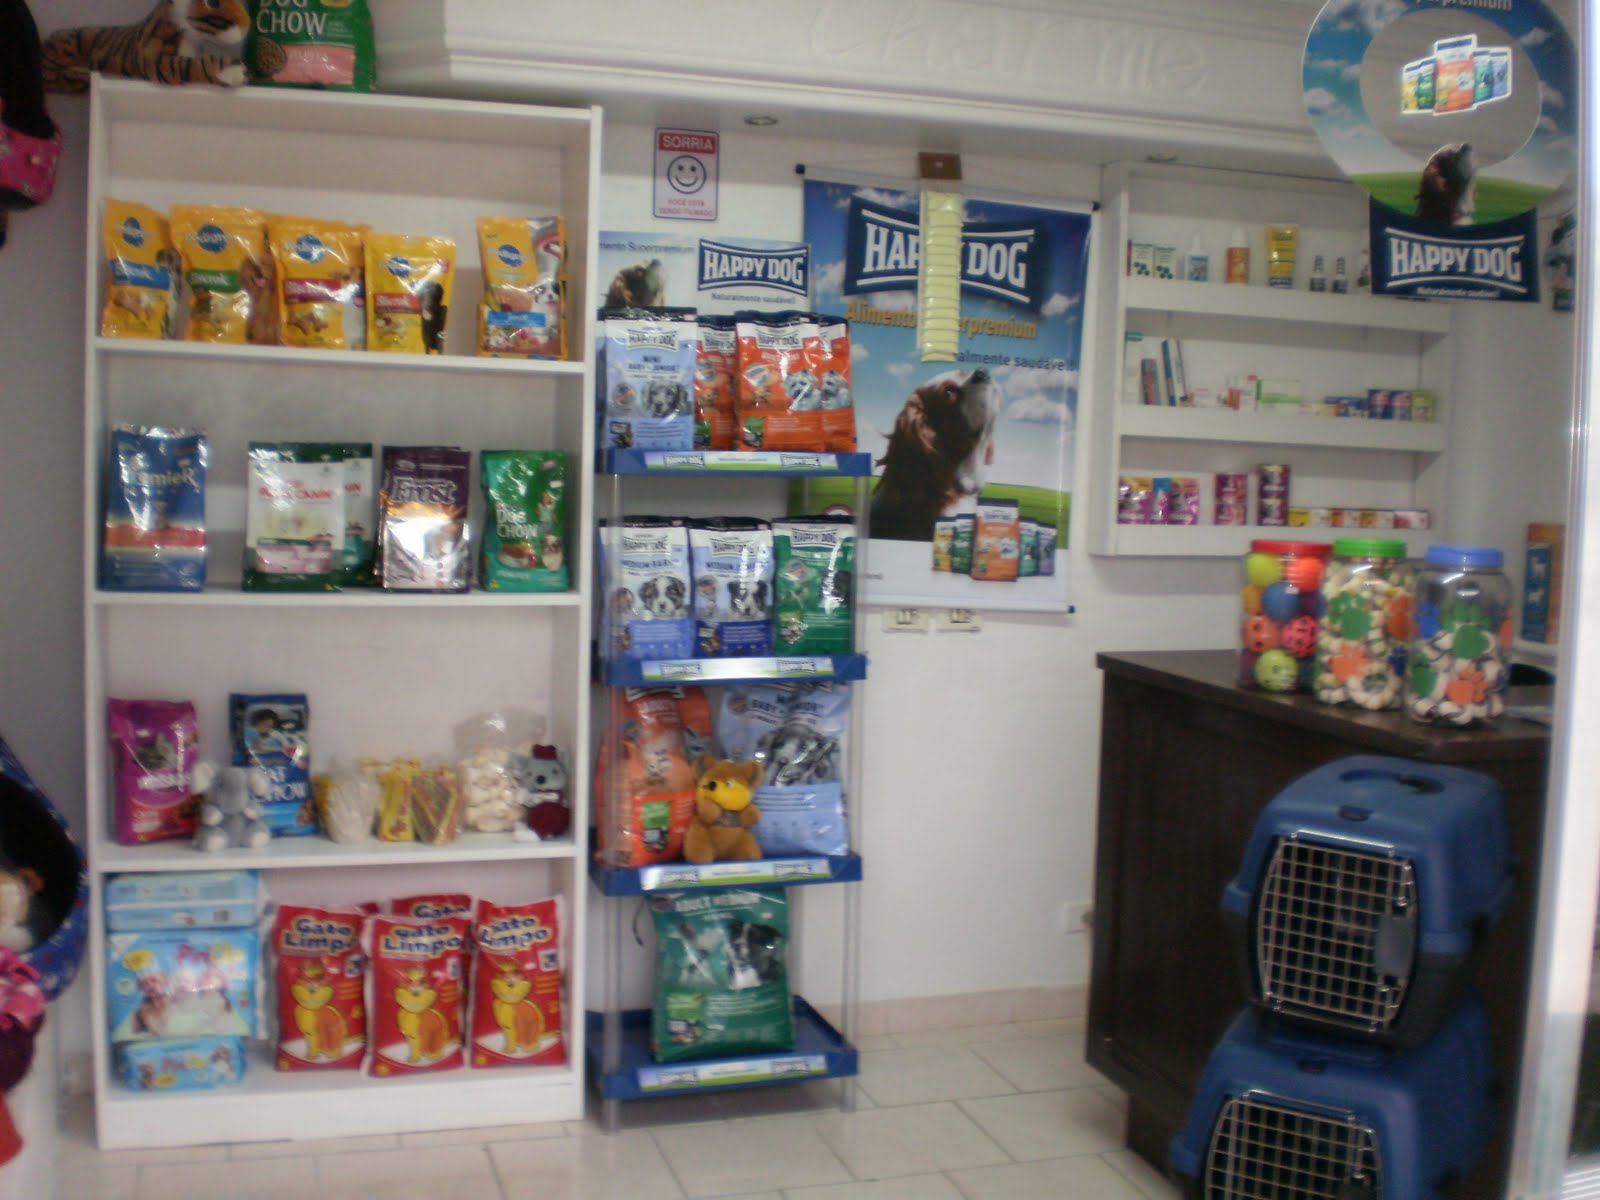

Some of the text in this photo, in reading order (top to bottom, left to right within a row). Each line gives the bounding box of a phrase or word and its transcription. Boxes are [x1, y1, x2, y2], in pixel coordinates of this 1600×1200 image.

[256, 9, 328, 34] CHOW
[662, 135, 714, 150] SORRIA
[703, 249, 805, 286] HAPPY DOG
[966, 242, 1029, 289] DOG
[1389, 237, 1523, 282] HAPPY DOG
[845, 298, 918, 329] Alimento
[294, 918, 352, 936] Gato
[480, 928, 548, 948] Limpo
[383, 936, 462, 956] Limpo
